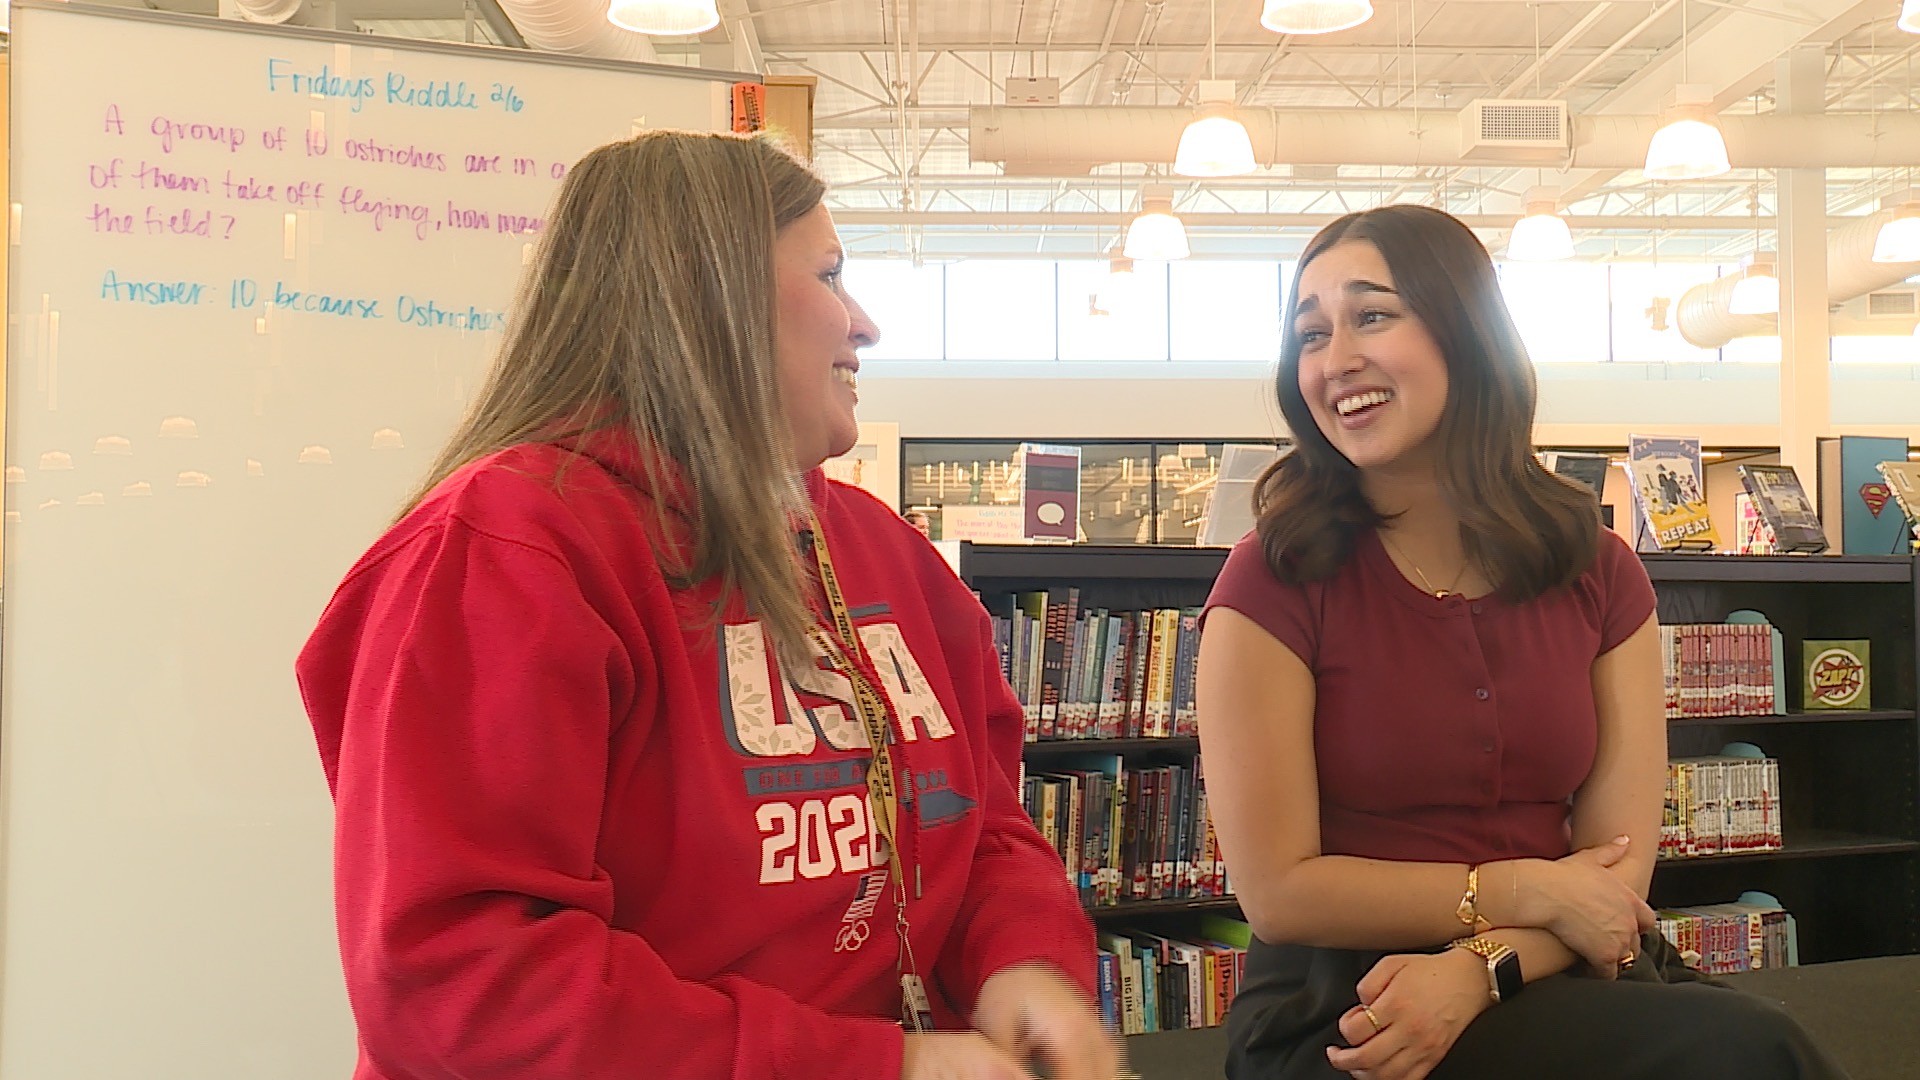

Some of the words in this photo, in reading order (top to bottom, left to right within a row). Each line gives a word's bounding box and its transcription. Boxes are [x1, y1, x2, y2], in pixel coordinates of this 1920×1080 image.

[268, 58, 375, 113] Fridays
[386, 71, 479, 108] Riddle
[105, 104, 125, 136] A
[151, 116, 245, 154] group
[262, 126, 288, 152] of
[305, 129, 328, 157] 10
[344, 138, 447, 172] ostriches
[464, 154, 502, 174] are
[514, 152, 536, 177] in
[550, 162, 565, 180] a
[131, 160, 210, 194] them
[222, 169, 278, 202] take
[286, 180, 325, 208] off
[448, 200, 490, 230] how
[86, 203, 135, 235] the
[101, 270, 217, 306] Answer:
[274, 281, 384, 319] because
[1660, 517, 1711, 543] REPEAT
[1136, 655, 1146, 676] SAFE
[1820, 668, 1854, 687] ZAP!
[719, 621, 955, 757] USA
[1134, 679, 1143, 702] PASS
[759, 769, 805, 789] ONE
[1124, 976, 1132, 994] BIG
[1124, 995, 1133, 1013] JIM
